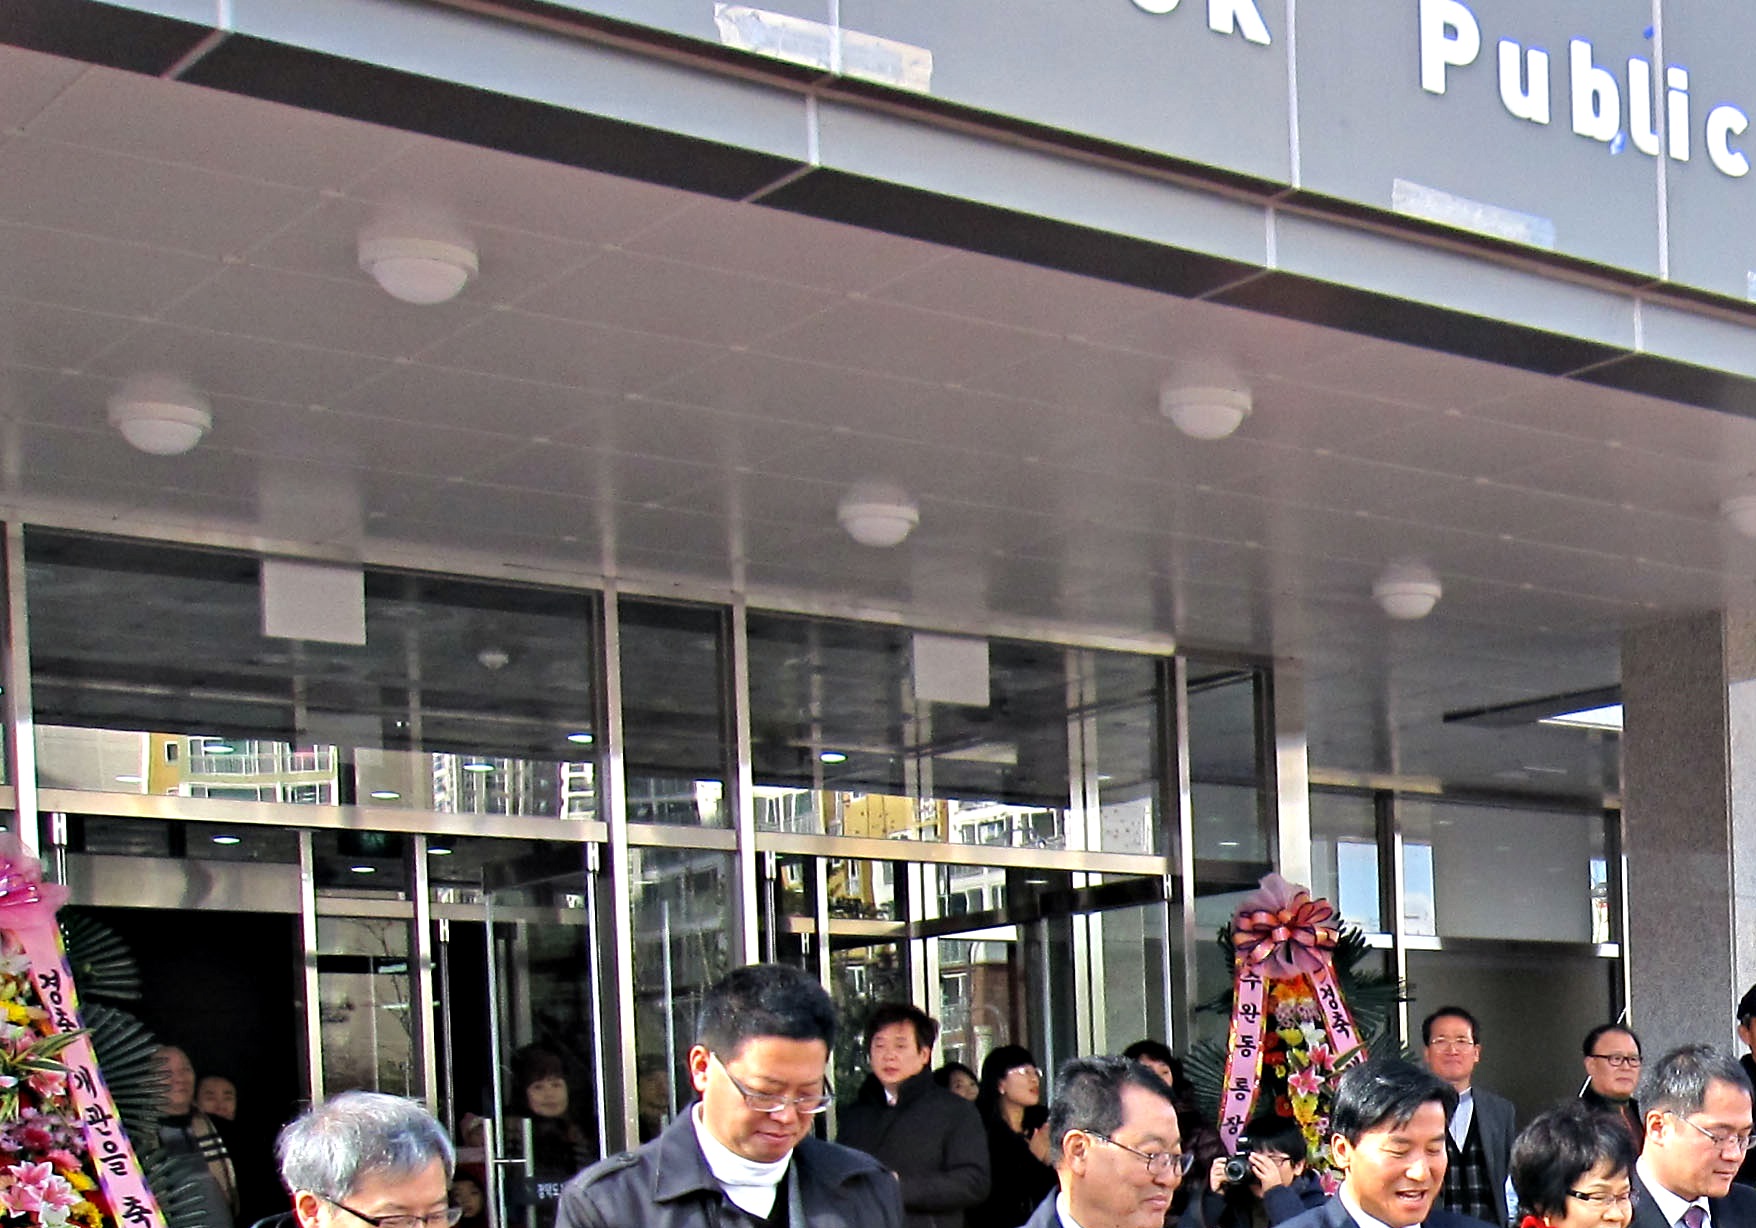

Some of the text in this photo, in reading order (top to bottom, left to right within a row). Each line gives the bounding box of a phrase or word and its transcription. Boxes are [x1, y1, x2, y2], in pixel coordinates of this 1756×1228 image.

[1419, 0, 1750, 177] Public
[1319, 983, 1351, 1039] 경축
[73, 1064, 129, 1176] 개관을
